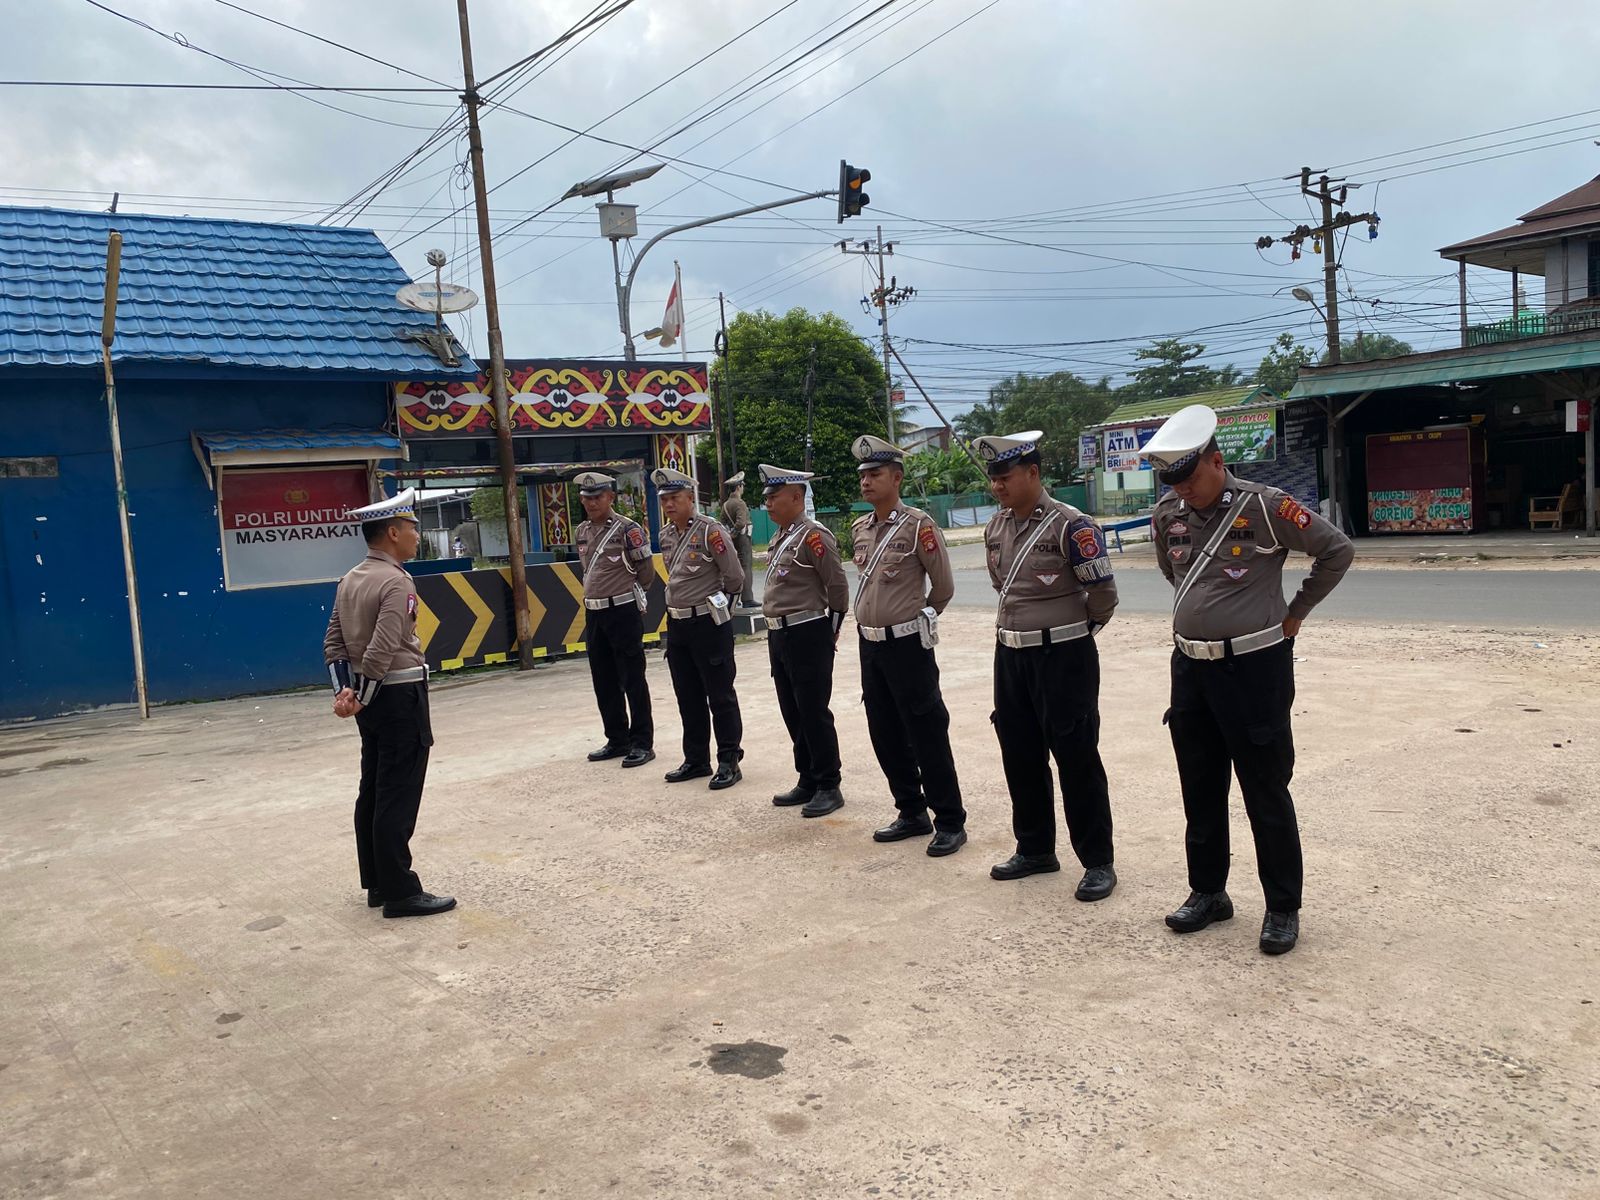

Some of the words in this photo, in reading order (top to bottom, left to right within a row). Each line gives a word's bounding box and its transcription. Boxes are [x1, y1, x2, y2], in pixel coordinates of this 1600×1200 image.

[1237, 411, 1269, 424] TAYLOR
[1109, 430, 1124, 438] MINI
[1107, 437, 1134, 452] ATM
[1107, 457, 1138, 468] BRILink
[234, 511, 291, 526] POLRI
[296, 508, 359, 523] UNTUK
[1373, 506, 1415, 522] GORENG
[1427, 502, 1471, 521] CRISPY
[235, 524, 361, 545] MASYARAKAT
[1228, 530, 1255, 540] OLRI
